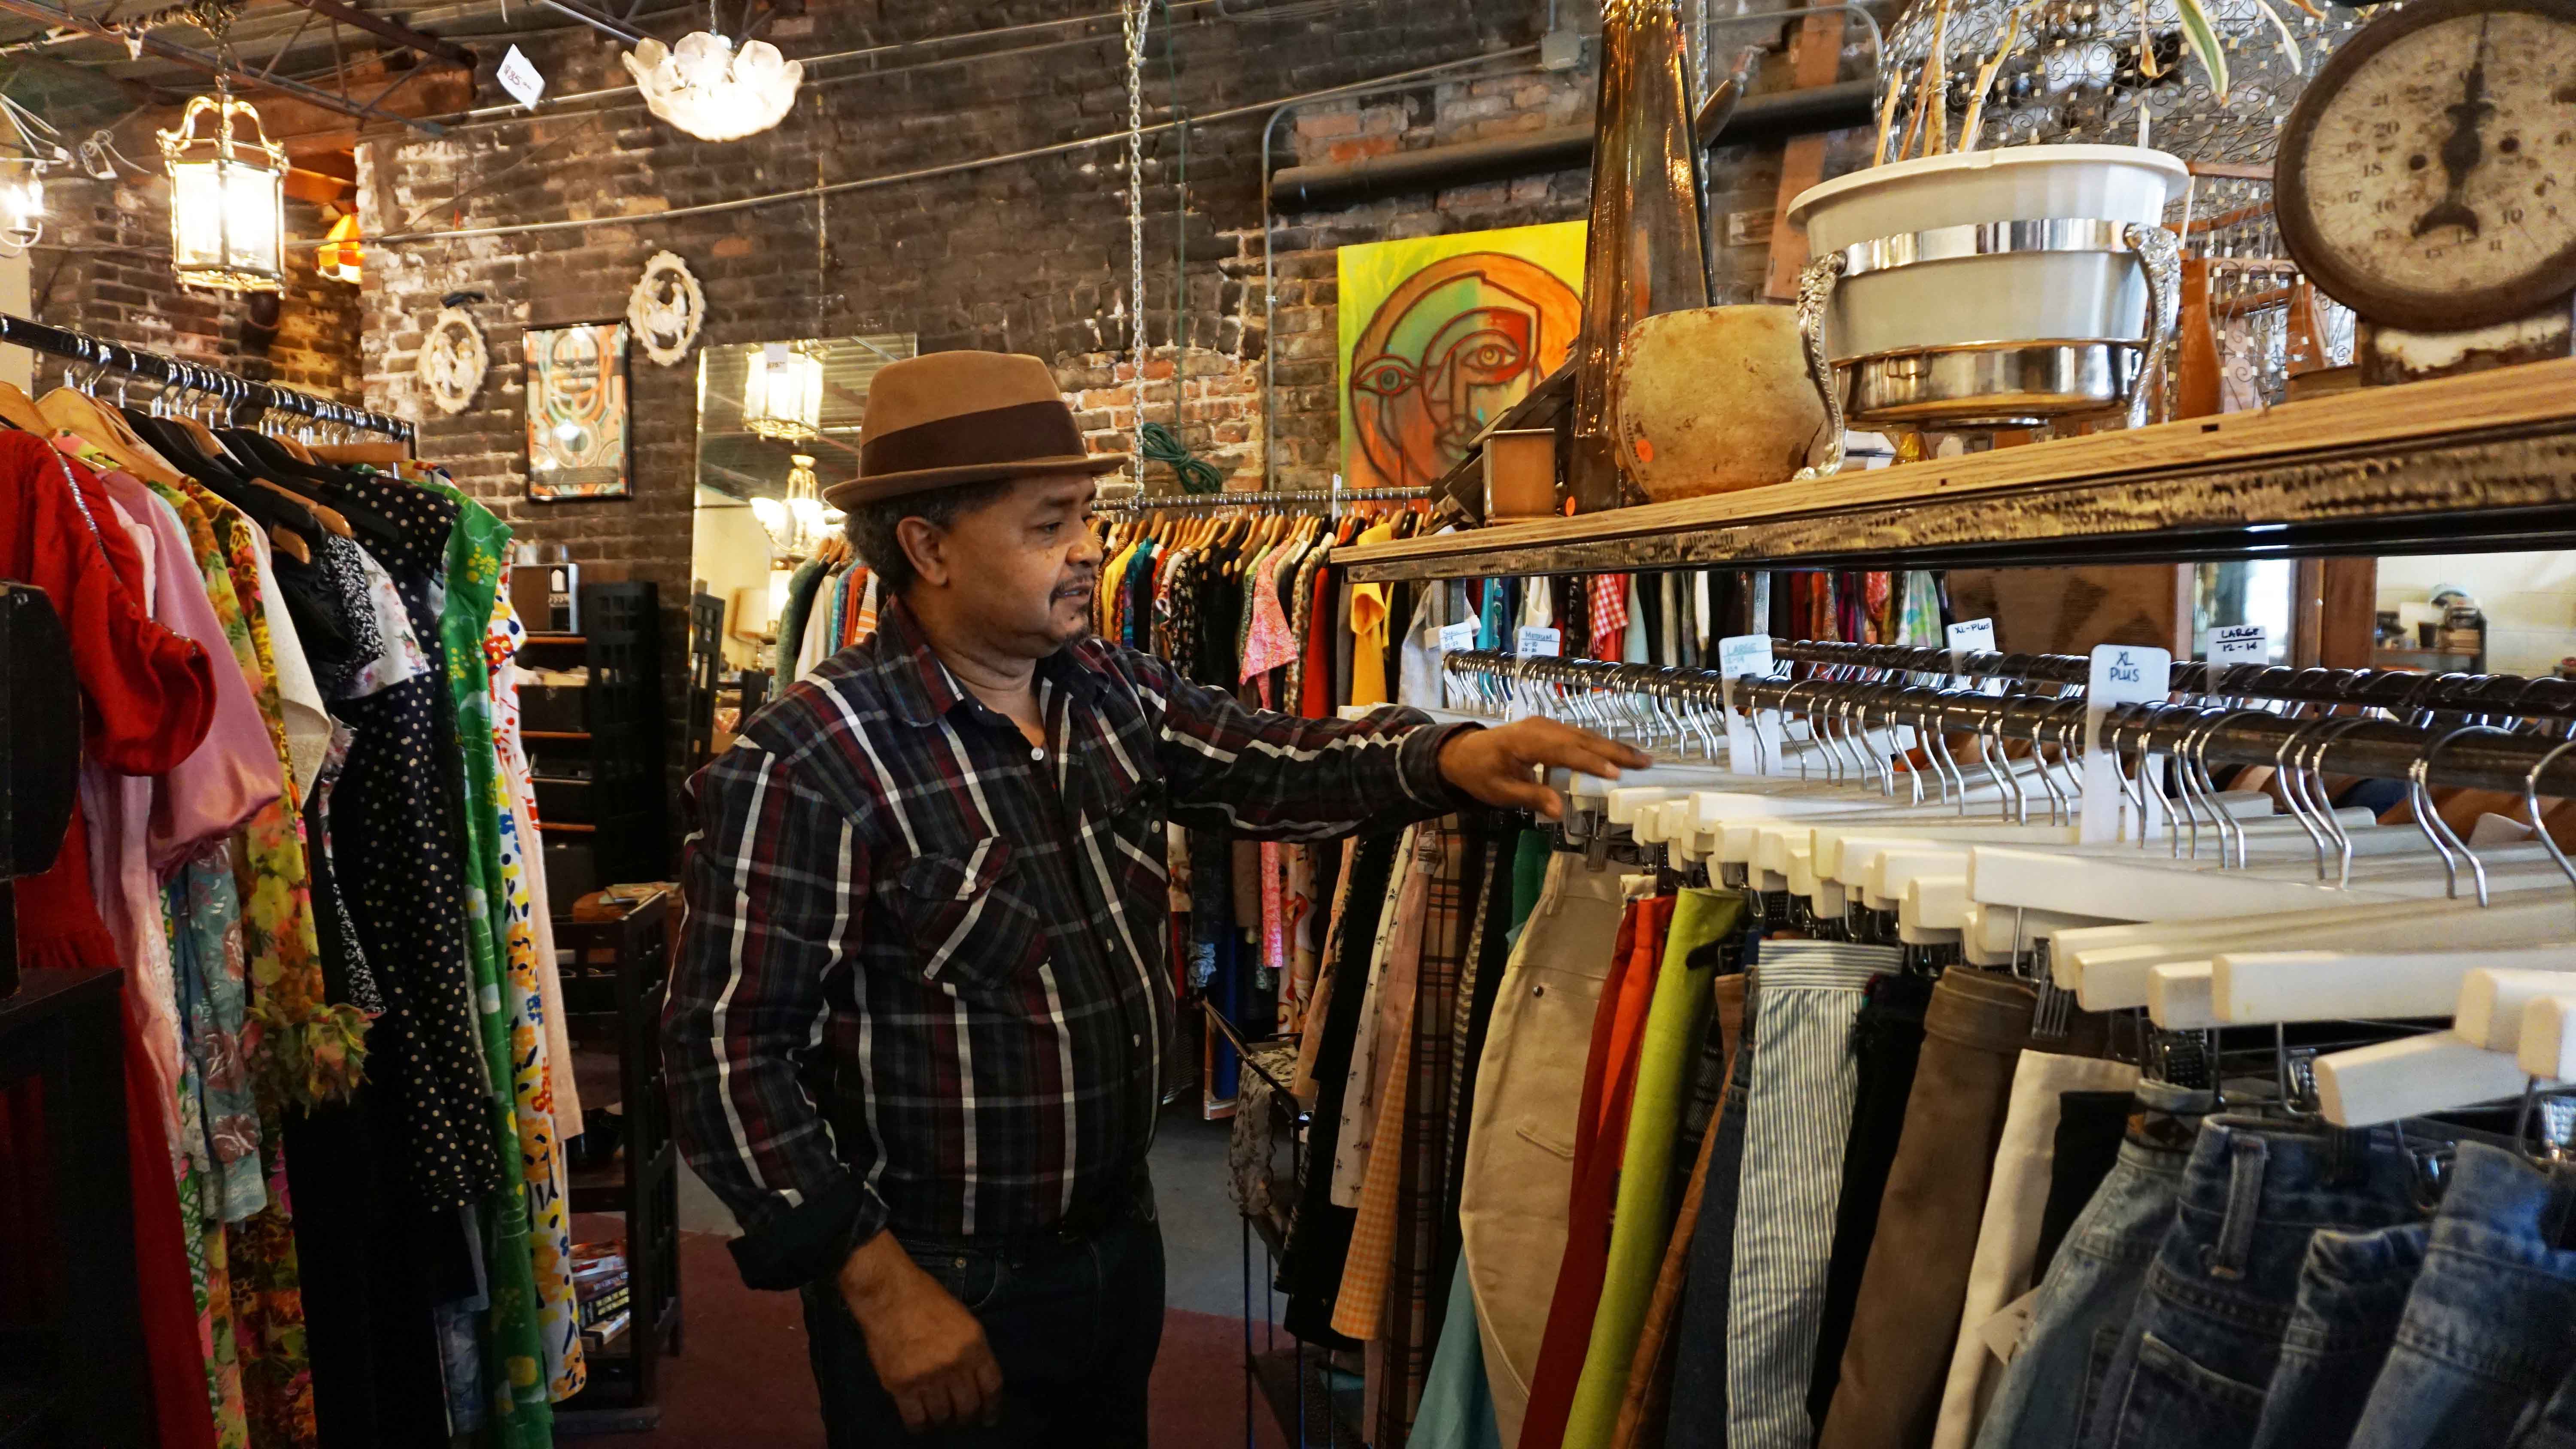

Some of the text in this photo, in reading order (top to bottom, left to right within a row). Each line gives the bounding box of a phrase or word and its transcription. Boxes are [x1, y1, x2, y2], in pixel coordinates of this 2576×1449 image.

[2374, 120, 2400, 139] 20
[2363, 163, 2384, 178] 18
[2502, 208, 2524, 224] 10
[2488, 240, 2503, 252] 11
[1525, 631, 1552, 640] MEDIUM
[2221, 628, 2260, 639] LARGE
[1727, 643, 1756, 655] LARGE
[2117, 651, 2135, 666] XL
